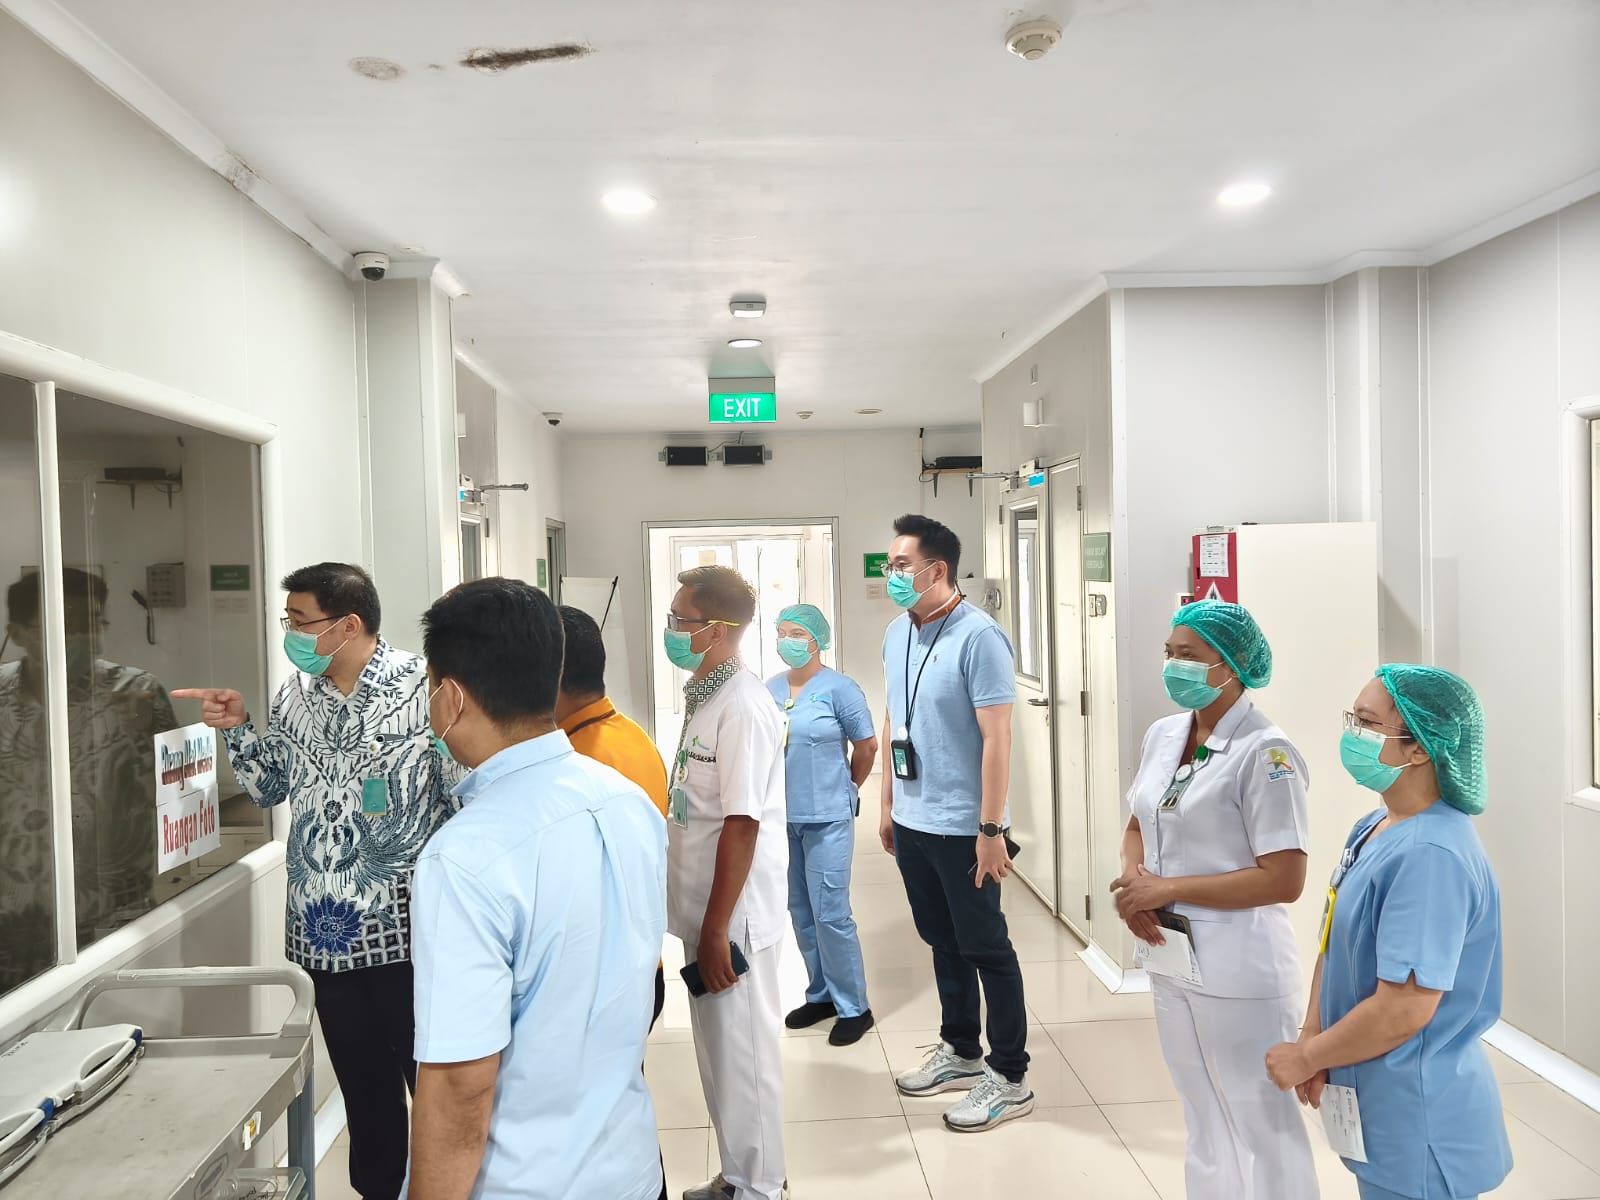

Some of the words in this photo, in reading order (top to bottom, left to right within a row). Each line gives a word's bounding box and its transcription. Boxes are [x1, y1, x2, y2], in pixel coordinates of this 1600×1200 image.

[724, 397, 761, 418] EXIT
[163, 814, 197, 857] Ruangan
[199, 799, 215, 838] Foto
